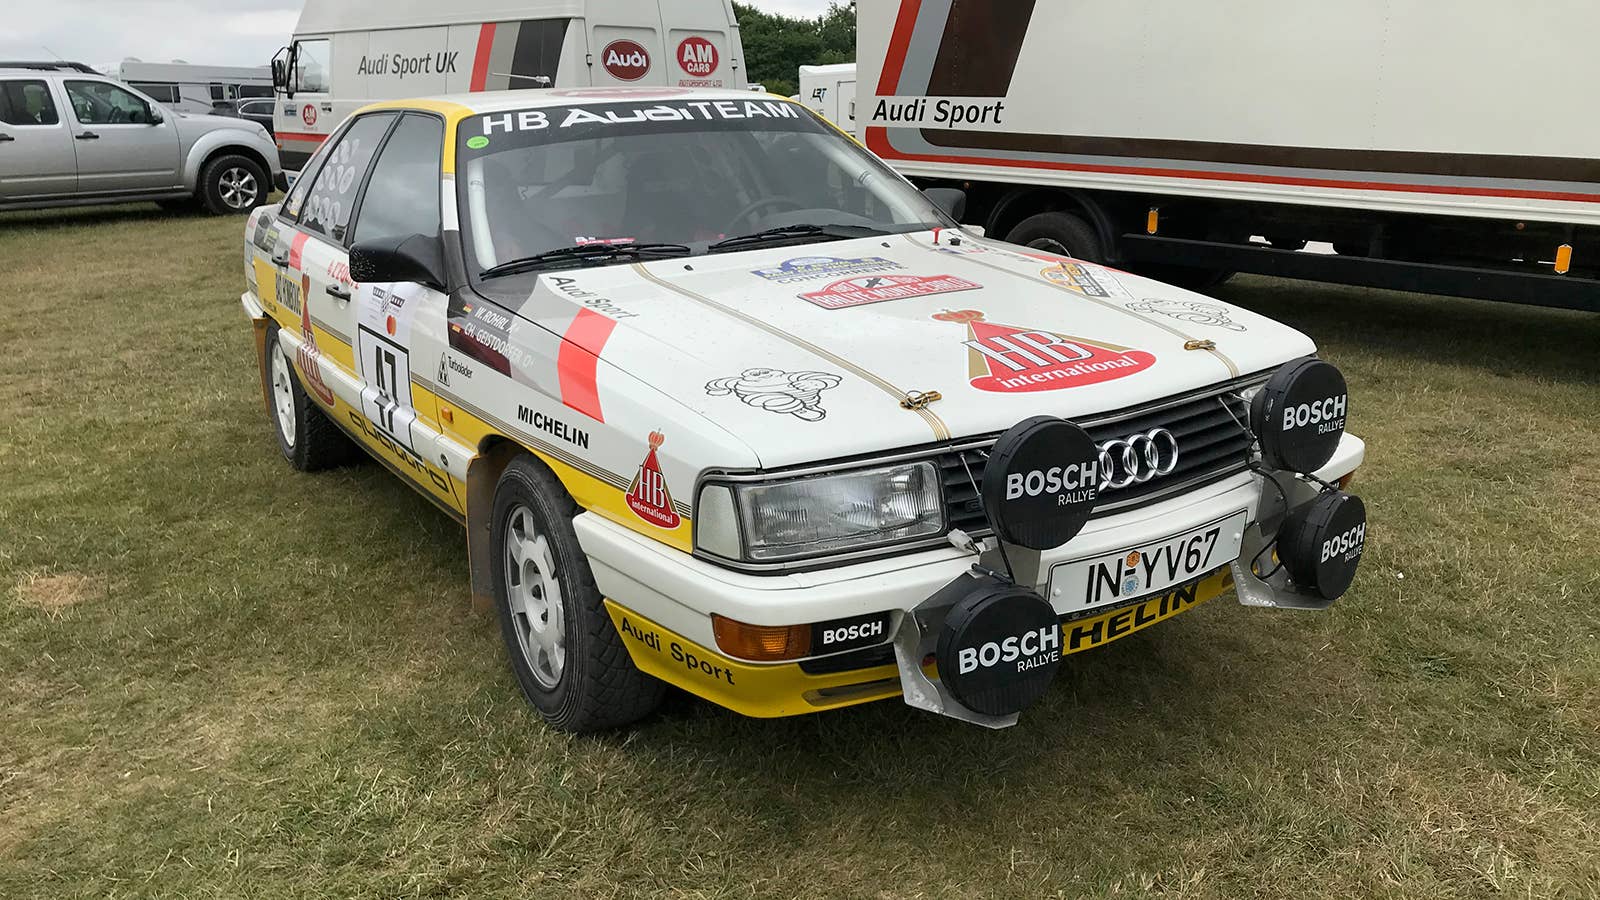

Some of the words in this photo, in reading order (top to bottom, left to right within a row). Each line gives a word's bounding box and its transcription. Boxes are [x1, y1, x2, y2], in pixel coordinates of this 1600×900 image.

[357, 53, 389, 75] Audi
[391, 53, 432, 79] Sport
[435, 51, 459, 74] UK
[605, 49, 647, 68] Audi
[683, 43, 714, 63] AM
[687, 62, 710, 73] CARS
[482, 111, 550, 135] HB
[559, 104, 694, 128] Audi
[687, 100, 799, 121] TEAM
[872, 98, 927, 121] Audi
[933, 99, 1005, 128] Sport
[584, 298, 641, 319] Sport
[960, 329, 1095, 372] HB
[996, 354, 1140, 389] international
[1282, 393, 1347, 431] BOSCH
[1318, 418, 1345, 435] RALLYE
[517, 404, 589, 450] MICHELIN
[639, 464, 665, 508] HB
[1006, 460, 1098, 500] BOSCH
[631, 498, 673, 524] international
[1057, 488, 1096, 506] RALLYE
[1320, 521, 1366, 564] BOSCH
[1344, 544, 1363, 563] RALLYE
[823, 620, 883, 645] BOSCH
[621, 616, 661, 652] Audi
[670, 642, 736, 686] Sport
[958, 624, 1059, 675] BOSCH
[1017, 650, 1060, 673] RALLYE
